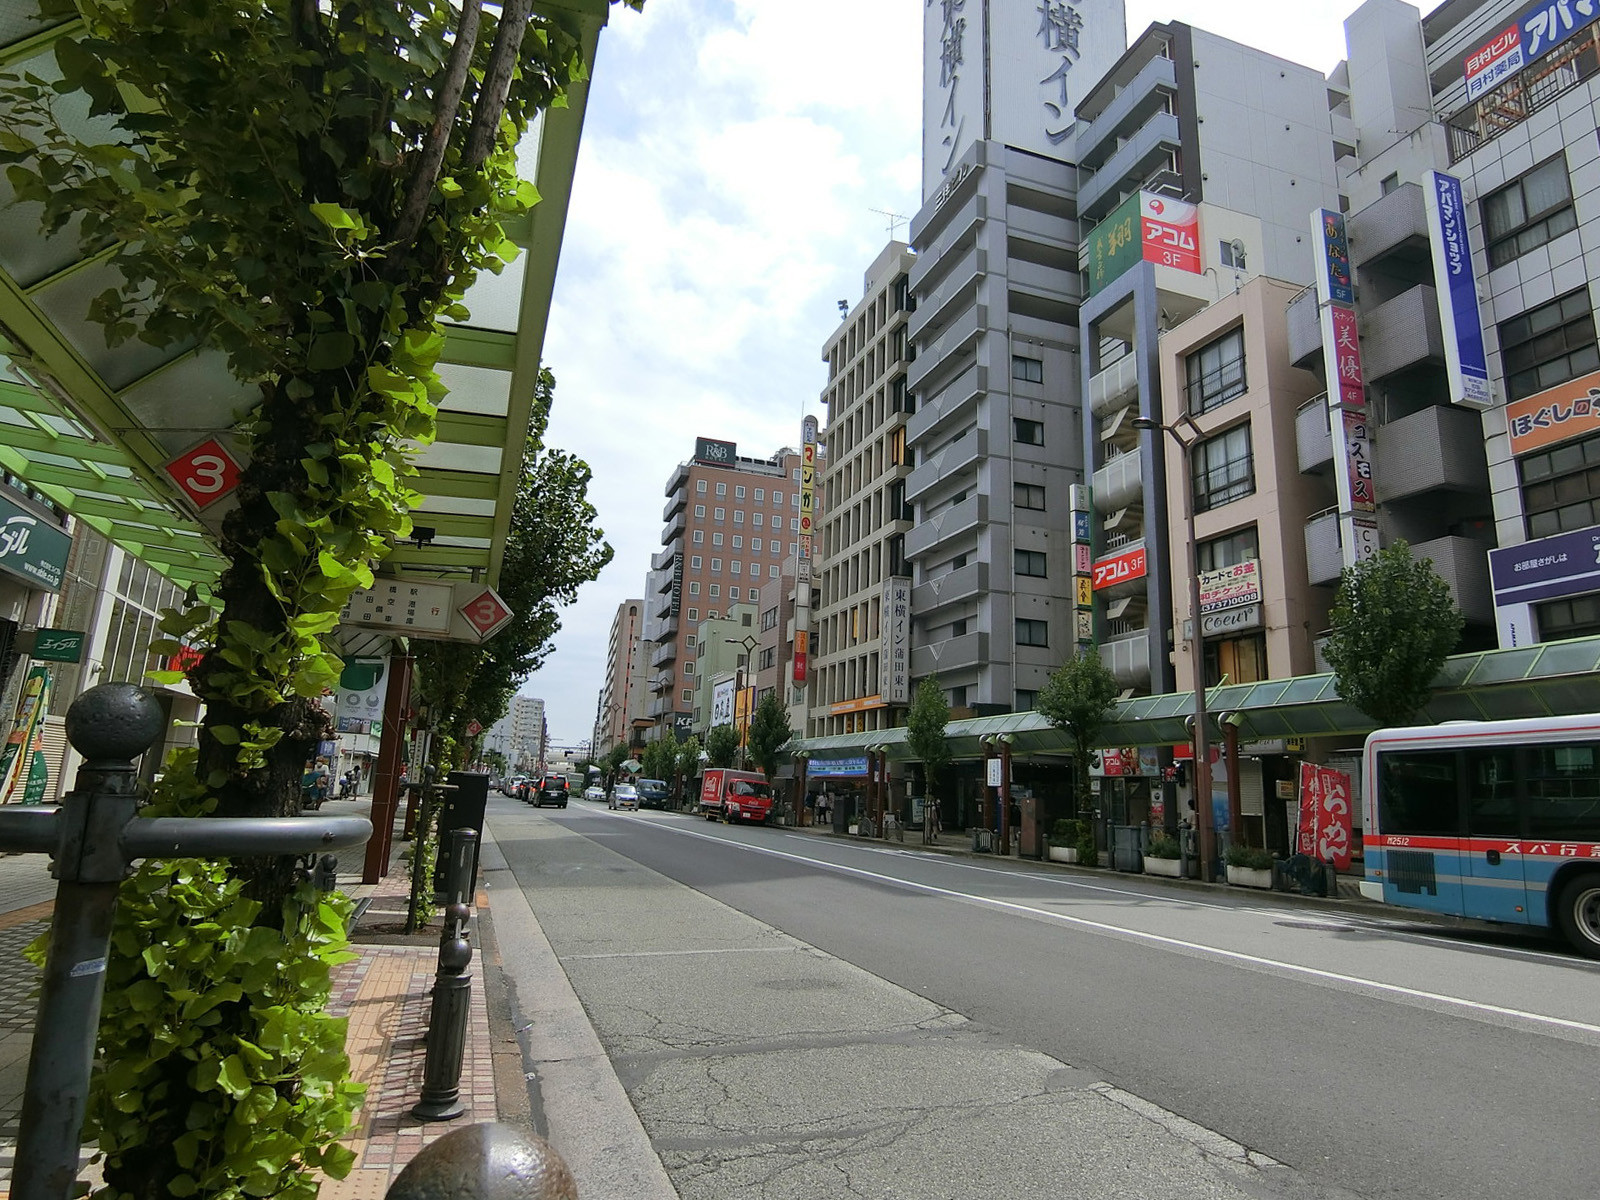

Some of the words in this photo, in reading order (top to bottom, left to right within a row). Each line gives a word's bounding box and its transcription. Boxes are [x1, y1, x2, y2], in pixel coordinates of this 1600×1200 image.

[1467, 32, 1517, 75] 月村ビル
[1036, 0, 1084, 146] 横イン
[1470, 51, 1520, 94] 月村薬局
[1146, 221, 1195, 251] アコム
[1439, 179, 1462, 275] アパマンショップ
[1162, 251, 1181, 266] 3F
[1336, 289, 1347, 298] 5F
[1333, 312, 1354, 322] スナック
[1338, 325, 1361, 382] 美優
[1347, 391, 1357, 400] 4F
[705, 444, 728, 459] R&B
[1351, 425, 1371, 500] コスモス
[186, 455, 226, 493] 3
[803, 447, 813, 508] マンガ
[1095, 559, 1130, 585] アコム
[1131, 557, 1144, 571] 3F
[1202, 562, 1255, 585] カードでお金
[1513, 553, 1568, 572] お部屋さがしは
[341, 611, 414, 624] 羽田車庫
[431, 607, 440, 616] 行
[474, 600, 497, 625] 3
[38, 638, 80, 650] エイブル
[894, 589, 906, 699] 東横イン蒲田東口
[1387, 836, 1410, 846] M2512
